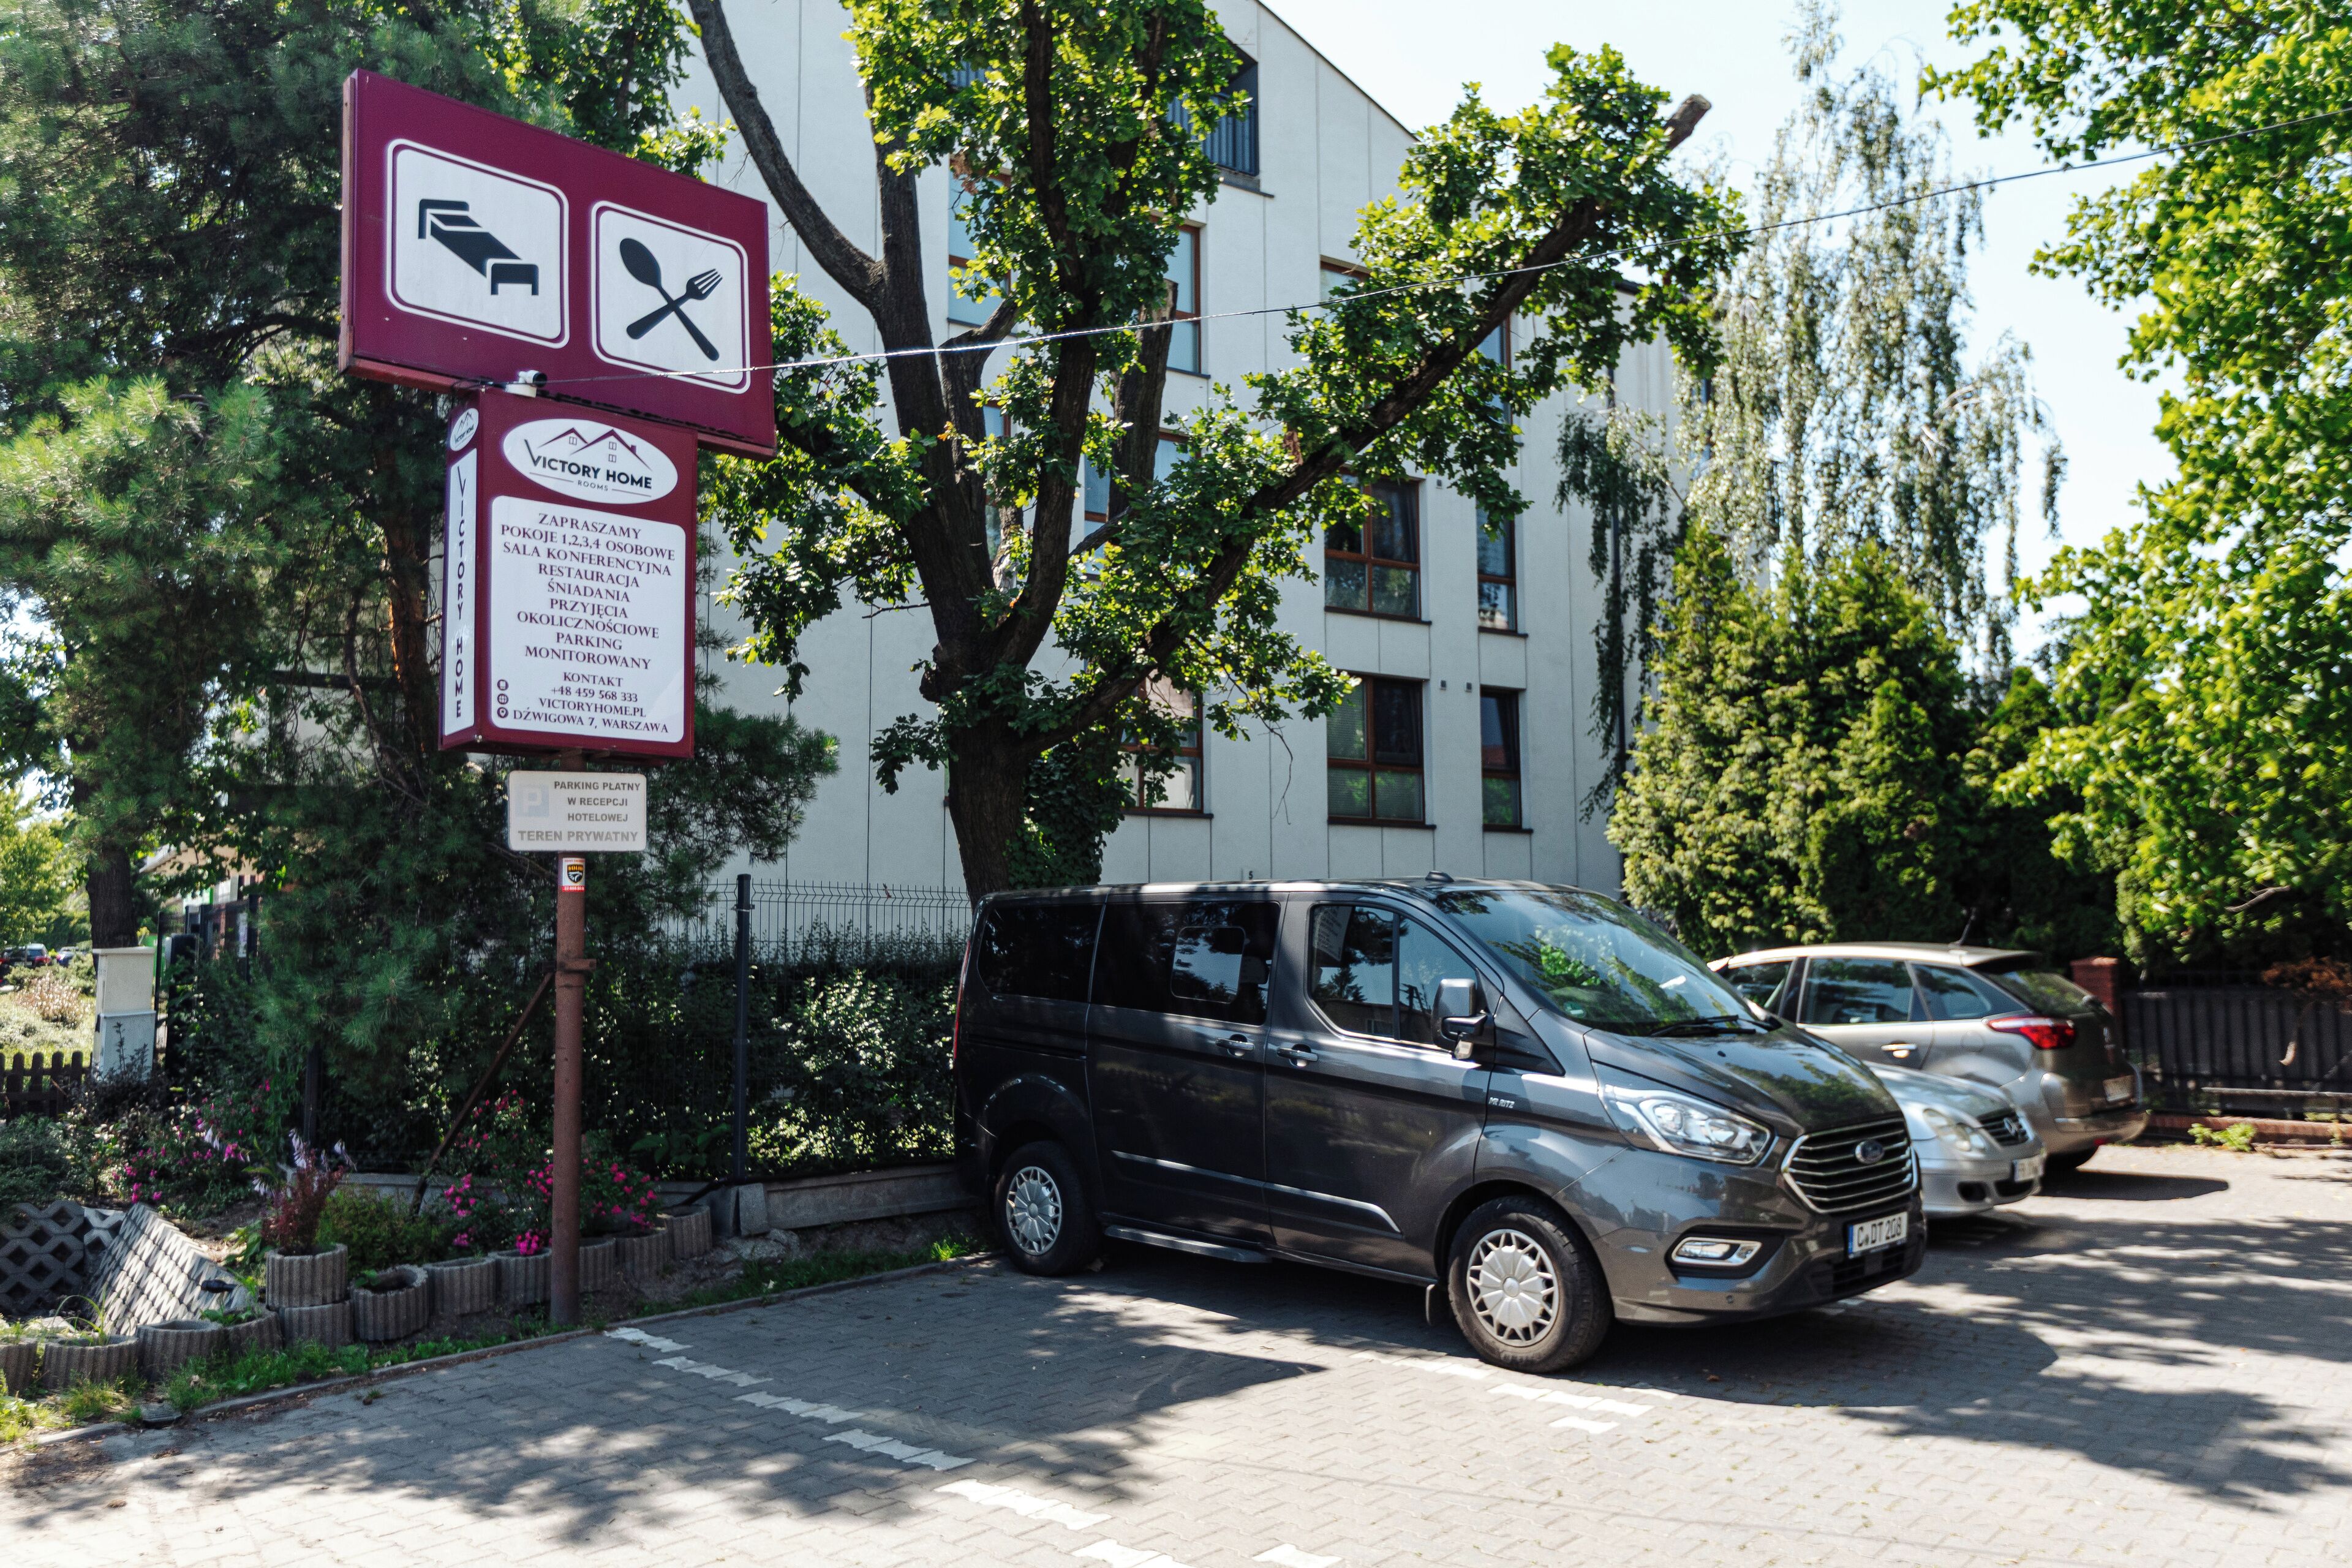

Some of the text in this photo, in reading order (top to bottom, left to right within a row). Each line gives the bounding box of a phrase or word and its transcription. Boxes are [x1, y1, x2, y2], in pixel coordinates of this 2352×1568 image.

[524, 439, 652, 489] VICTORY HOME
[578, 480, 608, 491] ROOMS
[538, 513, 642, 540] ZAPRASZAMY
[457, 466, 466, 620] VICTORY
[501, 524, 675, 561] POKOJE 1,2,3,4 OSOBOWE
[503, 541, 671, 577] SALA KONFERENCYJNA
[538, 563, 639, 588] RESTAURACJA
[548, 581, 630, 603] ŚNIADANIA
[550, 598, 628, 620] PRZYJĘCIA
[517, 611, 660, 639] OKOLICZNOŚCIOWE
[556, 632, 623, 650] PARKING
[525, 645, 651, 670] MONITOROWANY
[563, 672, 624, 687] KONTAKT
[551, 686, 638, 703] +48 459 568 333
[539, 698, 647, 717] VICTORYHOME.PL
[513, 707, 669, 733] DŹWIGOWA 7, WARSZAWA
[554, 781, 641, 791] PARKING PŁATNY
[567, 797, 628, 807] W RECEPCJI
[567, 813, 628, 822] HOTELOWEJ
[518, 831, 638, 842] TEREN PRYWATNY
[1248, 870, 1253, 880] 5
